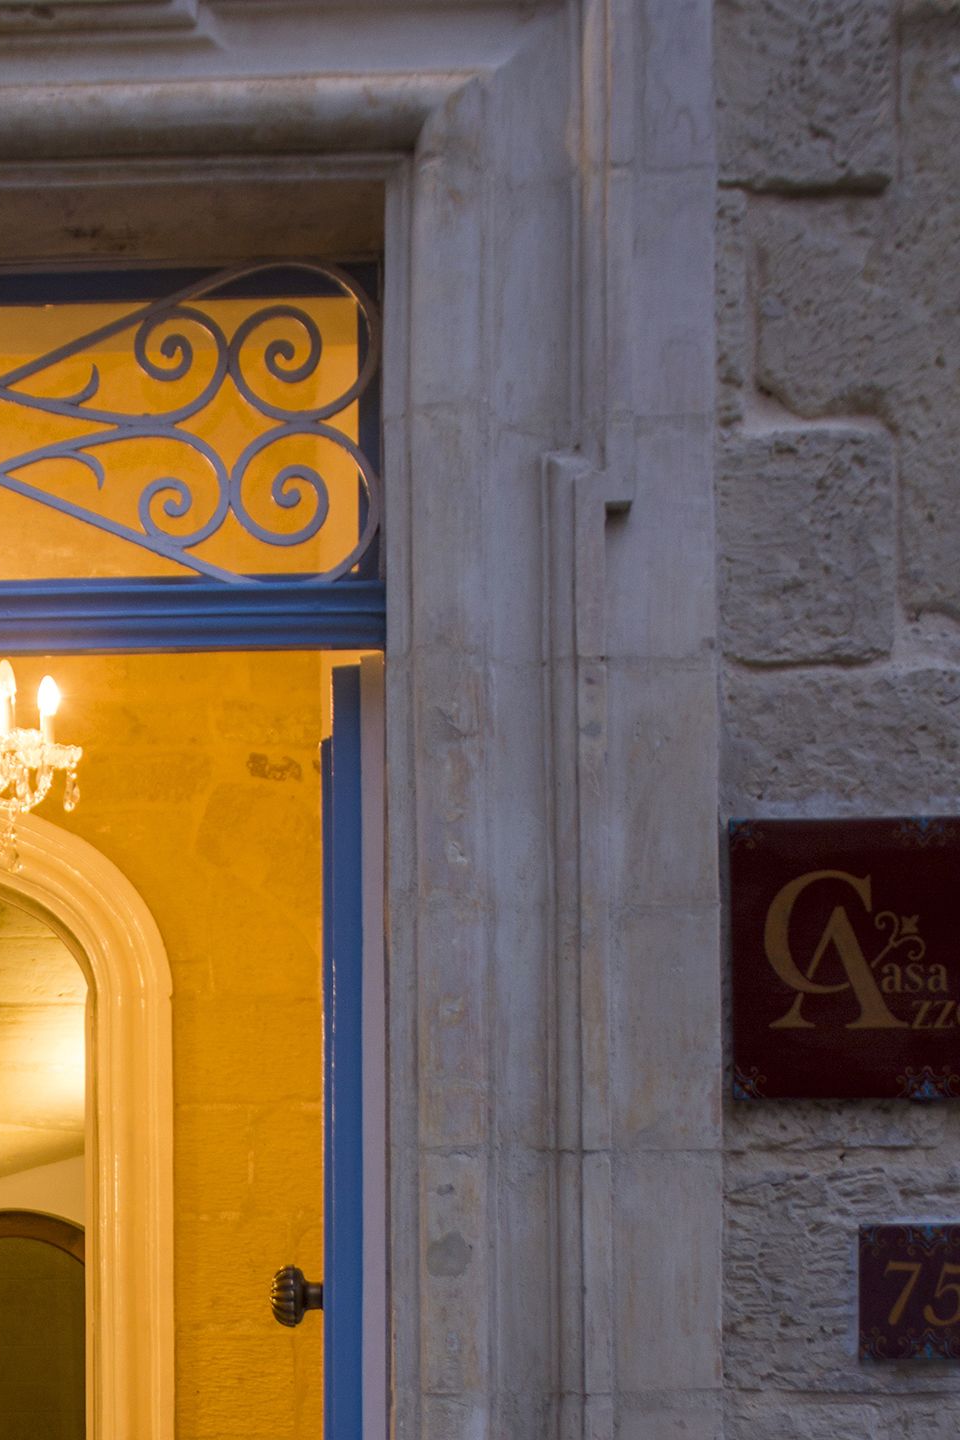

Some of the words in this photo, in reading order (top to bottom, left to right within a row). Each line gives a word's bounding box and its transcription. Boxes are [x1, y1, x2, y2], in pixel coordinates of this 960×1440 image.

[764, 869, 948, 994] Casa
[769, 905, 960, 1030] Azz
[884, 1260, 960, 1326] 75
